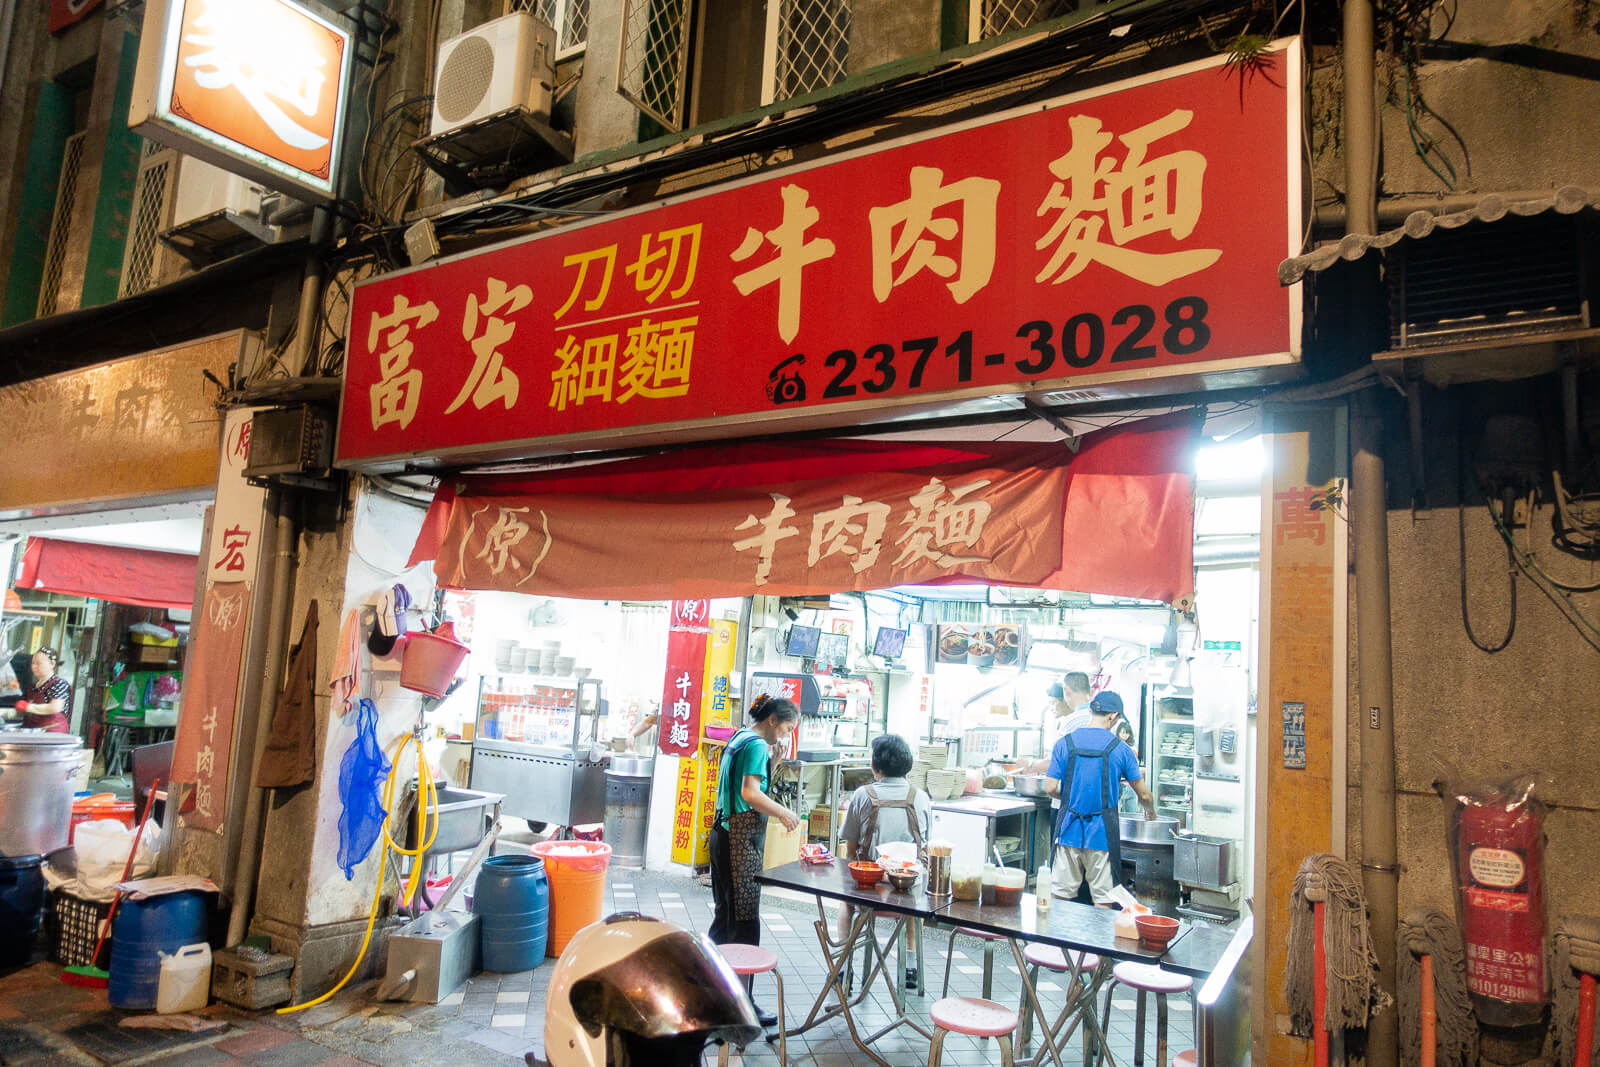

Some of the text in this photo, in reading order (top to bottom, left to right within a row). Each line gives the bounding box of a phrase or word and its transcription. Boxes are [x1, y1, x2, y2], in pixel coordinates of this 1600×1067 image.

[553, 222, 703, 321] 刀切
[730, 108, 1223, 345] 牛肉麵
[367, 277, 534, 432] 富宏
[548, 315, 700, 411] 細麵
[822, 295, 1212, 399] 2371-3028
[733, 475, 1002, 587] 牛肉麵
[669, 671, 692, 749] 牛肉麵
[675, 766, 695, 850] 牛肉細粉
